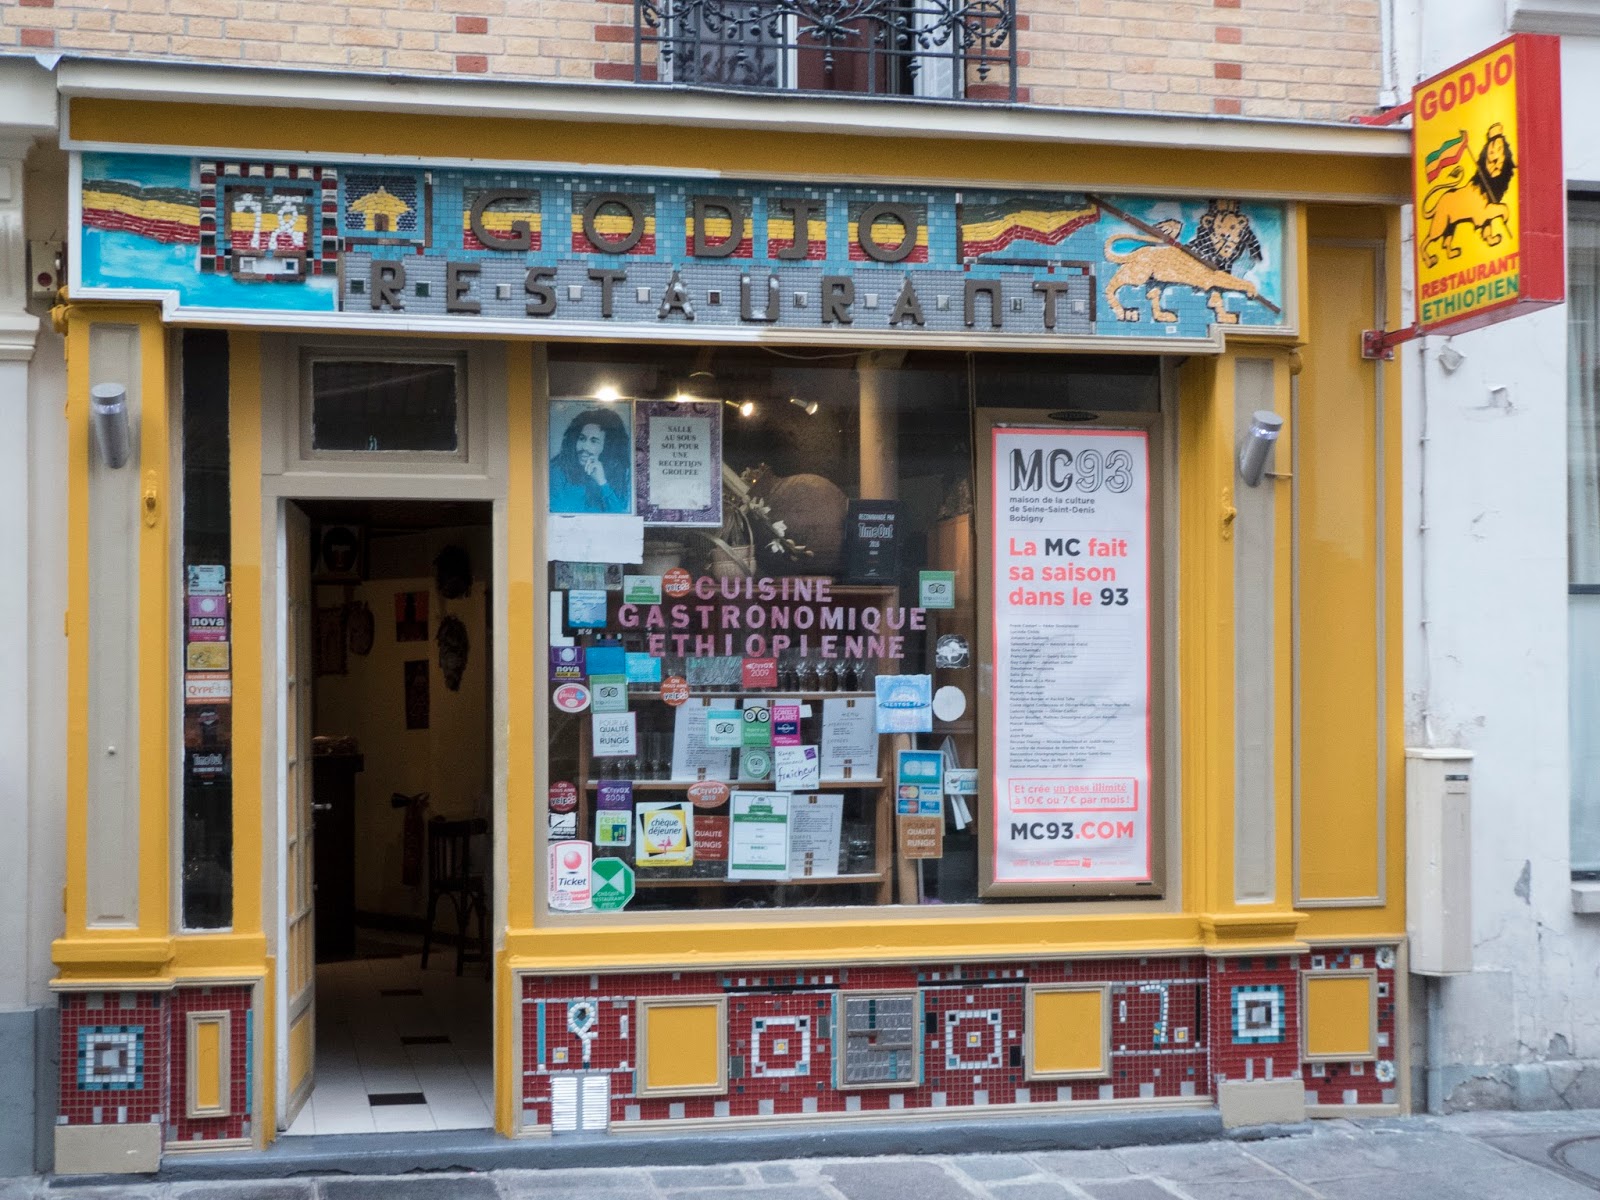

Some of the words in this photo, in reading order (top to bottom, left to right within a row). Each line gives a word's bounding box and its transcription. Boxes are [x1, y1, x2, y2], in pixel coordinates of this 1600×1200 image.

[1419, 52, 1514, 122] GODJO
[468, 188, 918, 264] GODJO
[1421, 252, 1519, 300] RESTAURANT
[370, 258, 1069, 331] RESTAURANT
[1421, 273, 1519, 322] ETHIOPIEN
[668, 425, 692, 433] SALLE
[658, 461, 703, 469] RECEPTION
[1009, 448, 1133, 493] MC93
[1042, 496, 1053, 504] de
[1055, 496, 1063, 504] la
[1065, 497, 1095, 505] culture
[1022, 506, 1095, 514] Seine-Saint-Denis
[1009, 515, 1044, 523] Bobigny
[1009, 537, 1036, 556] La
[1045, 538, 1081, 556] MC
[1088, 537, 1127, 557] fait
[1009, 566, 1034, 581] sa
[1041, 562, 1116, 581] saison
[695, 576, 832, 603] CUISINE
[1009, 586, 1065, 605] dans
[1073, 586, 1092, 605] le
[1100, 587, 1129, 606] 93
[191, 617, 225, 626] nova
[617, 603, 926, 631] GASTRONOMIQUE
[649, 633, 904, 659] ETHIOPIENNE
[556, 665, 580, 673] nova
[750, 669, 769, 677] 2009
[600, 737, 629, 745] RUNGIS
[1014, 784, 1024, 793] Et
[1028, 784, 1050, 793] crée
[1054, 785, 1065, 793] un
[1068, 785, 1089, 794] pass
[1092, 783, 1126, 792] illimité
[1014, 796, 1021, 805] à
[1080, 797, 1097, 806] par
[600, 815, 627, 824] resto
[651, 818, 678, 829] chèque
[648, 826, 682, 836] déjeuner
[1010, 820, 1134, 840] MC93.COM
[694, 841, 722, 849] RUNGIS
[558, 877, 587, 887] Ticket
